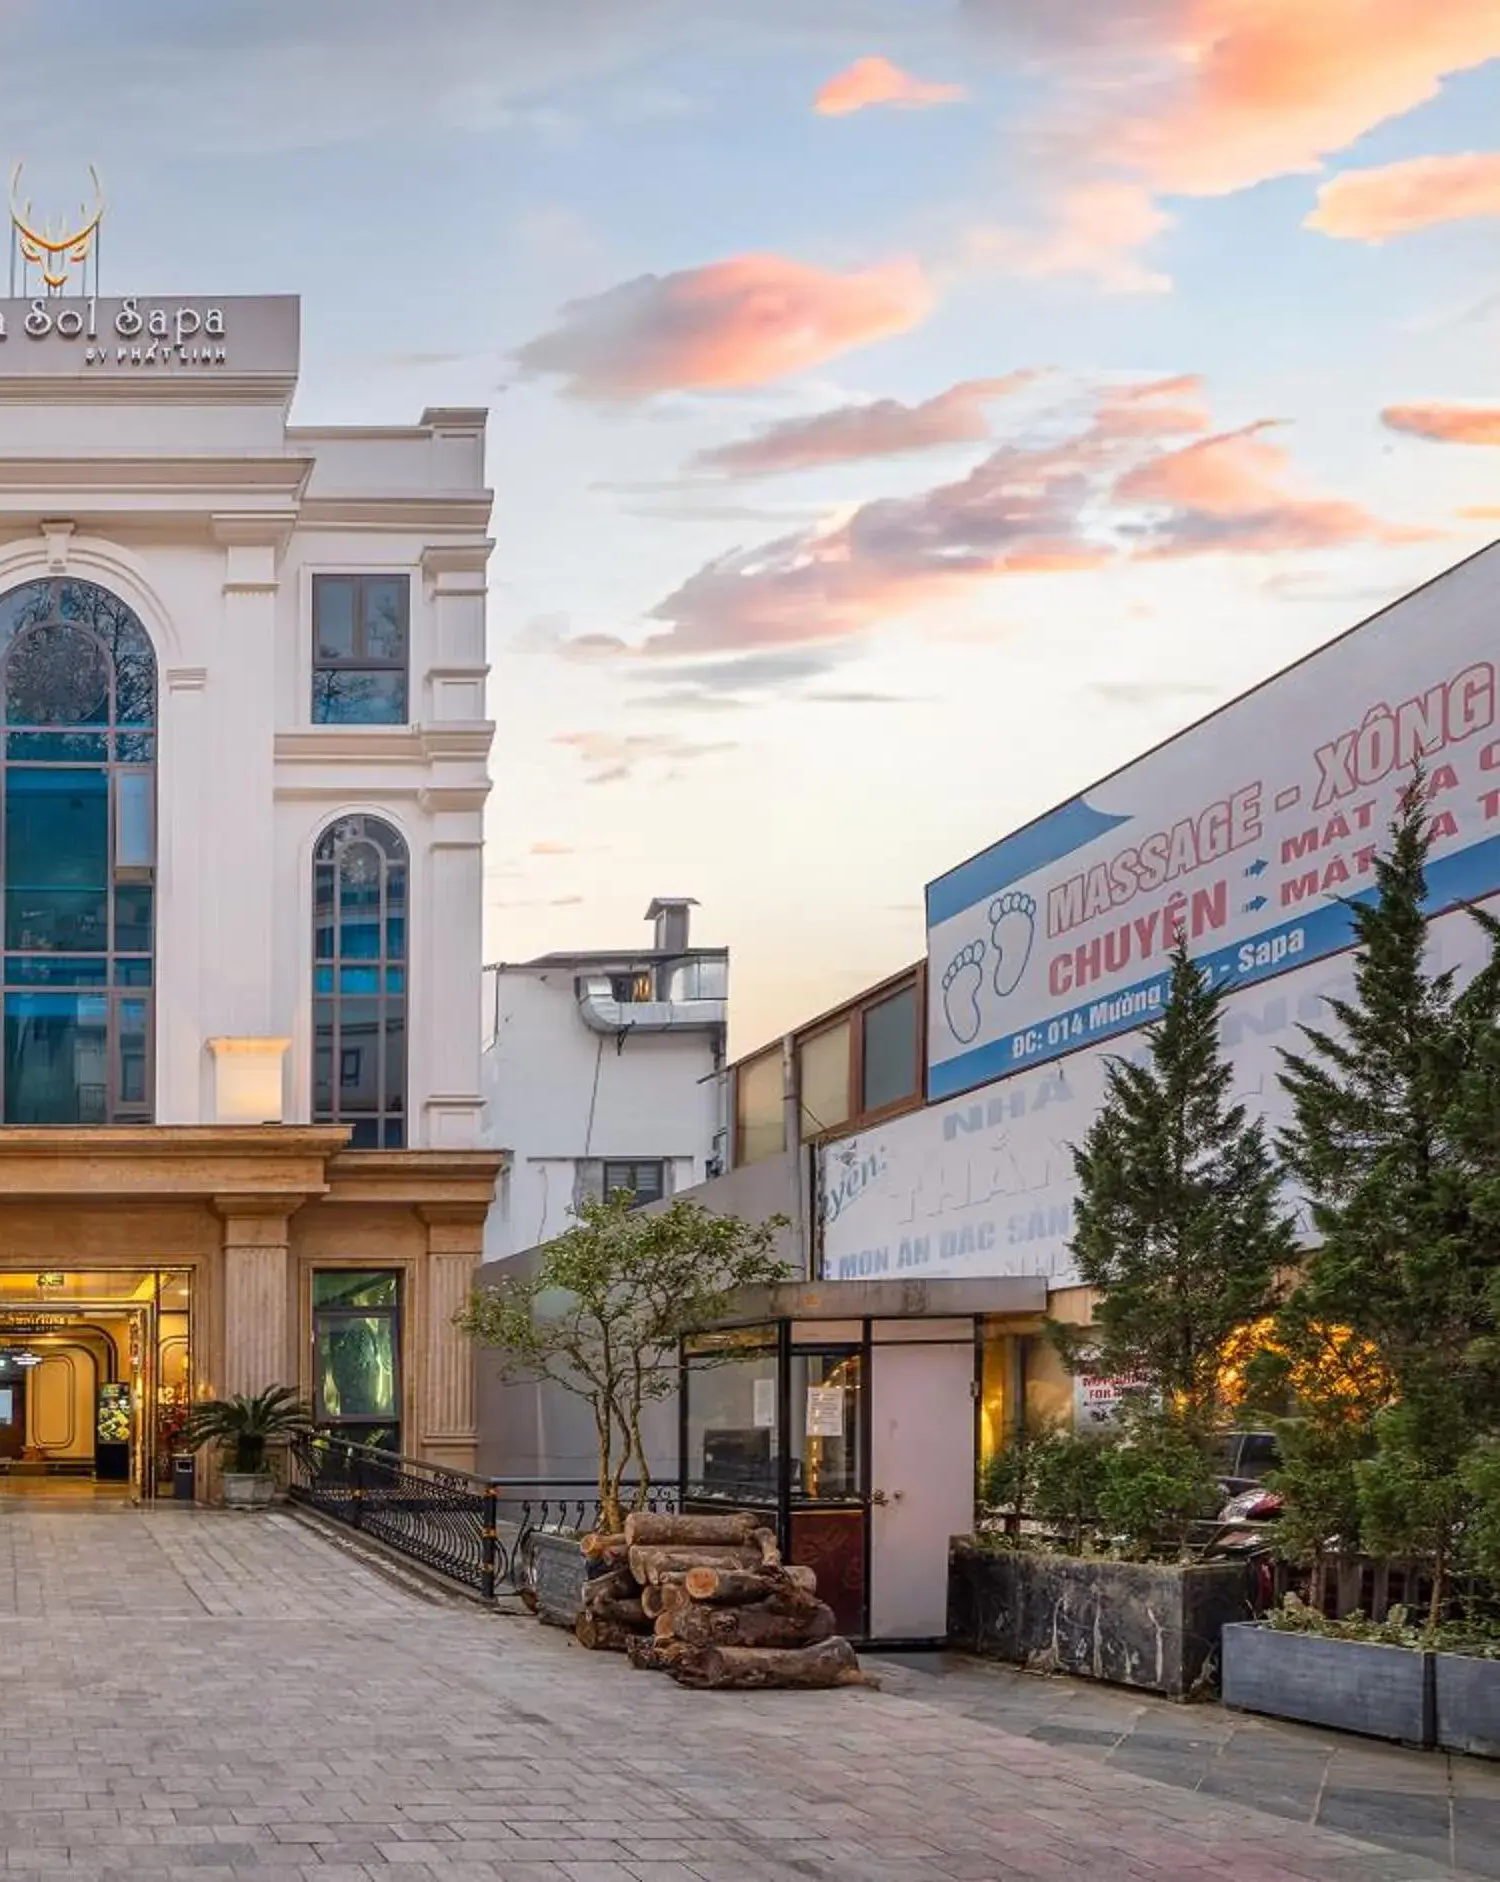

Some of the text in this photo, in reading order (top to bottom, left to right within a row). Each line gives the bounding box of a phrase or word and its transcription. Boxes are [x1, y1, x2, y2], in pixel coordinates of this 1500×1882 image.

[24, 297, 97, 339] Sol
[115, 297, 226, 348] Sapa
[85, 347, 107, 363] BY
[179, 347, 226, 364] LINH
[1047, 780, 1263, 939] MASSAGE
[1312, 661, 1495, 812] XÔNG
[1047, 1013, 1084, 1045] 014
[1237, 927, 1305, 973] Sapa
[1049, 879, 1228, 997] CHUYÊN
